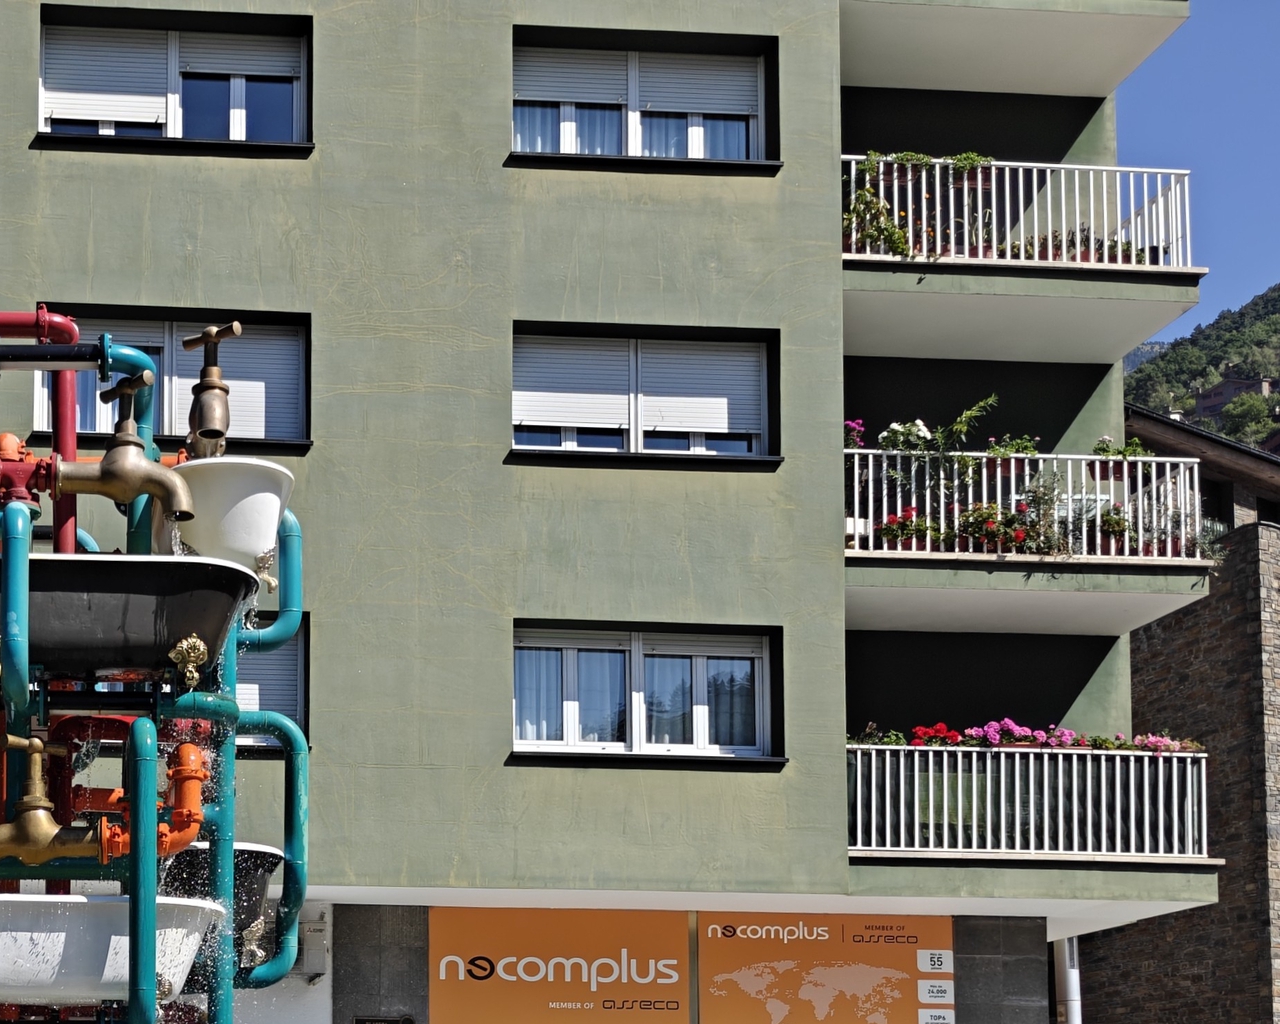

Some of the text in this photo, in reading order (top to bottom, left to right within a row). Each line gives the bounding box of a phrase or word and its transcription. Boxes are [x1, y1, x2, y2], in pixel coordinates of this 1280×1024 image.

[707, 921, 829, 944] necomplus
[852, 934, 918, 944] asseco
[929, 956, 943, 967] 55
[439, 948, 680, 991] necomplus
[602, 1000, 680, 1011] asseco
